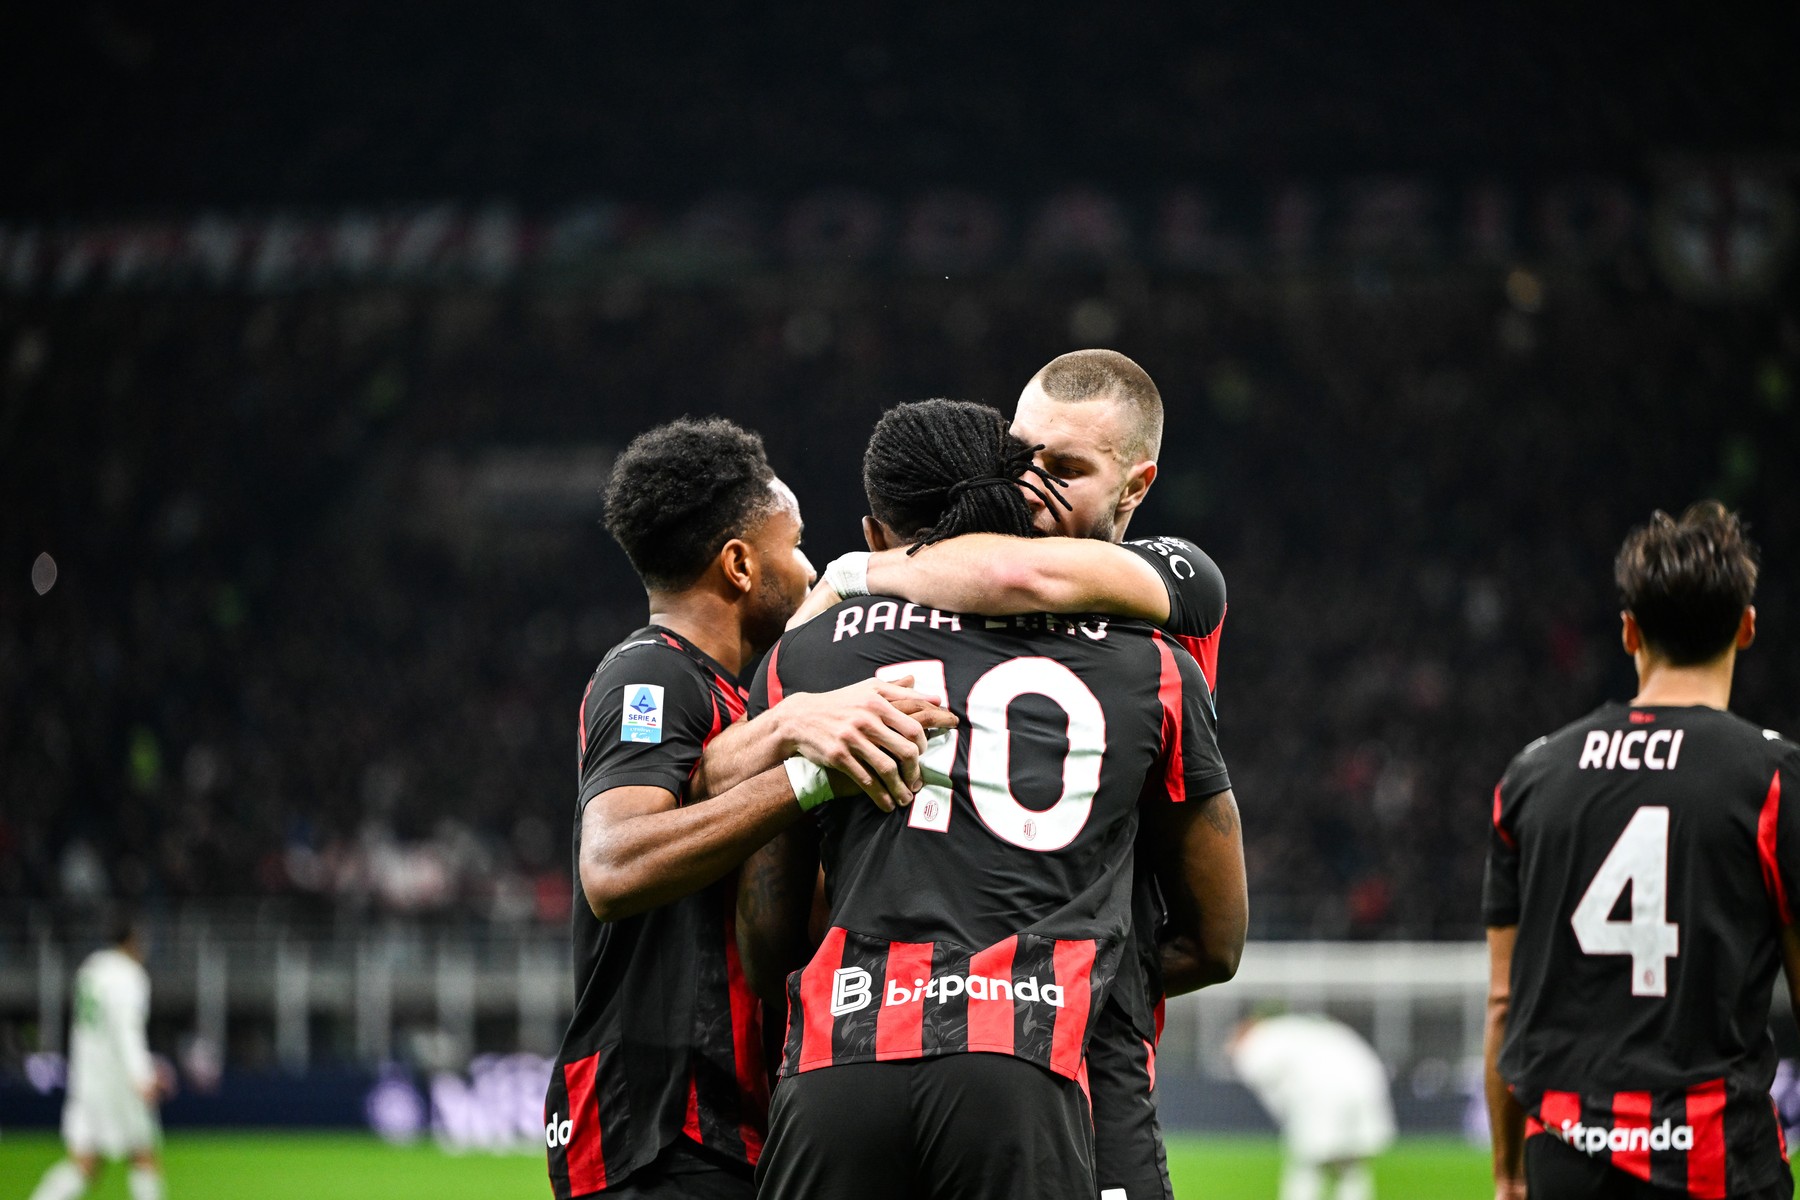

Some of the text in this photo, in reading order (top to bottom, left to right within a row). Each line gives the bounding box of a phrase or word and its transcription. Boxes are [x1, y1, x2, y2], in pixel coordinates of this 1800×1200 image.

[628, 713, 649, 721] SERIE
[875, 656, 1106, 852] 10
[1579, 729, 1684, 770] RICCI
[1571, 806, 1679, 997] 4
[885, 974, 1065, 1008] bitpanda
[546, 1111, 574, 1149] da
[1543, 1118, 1694, 1158] itpanda
